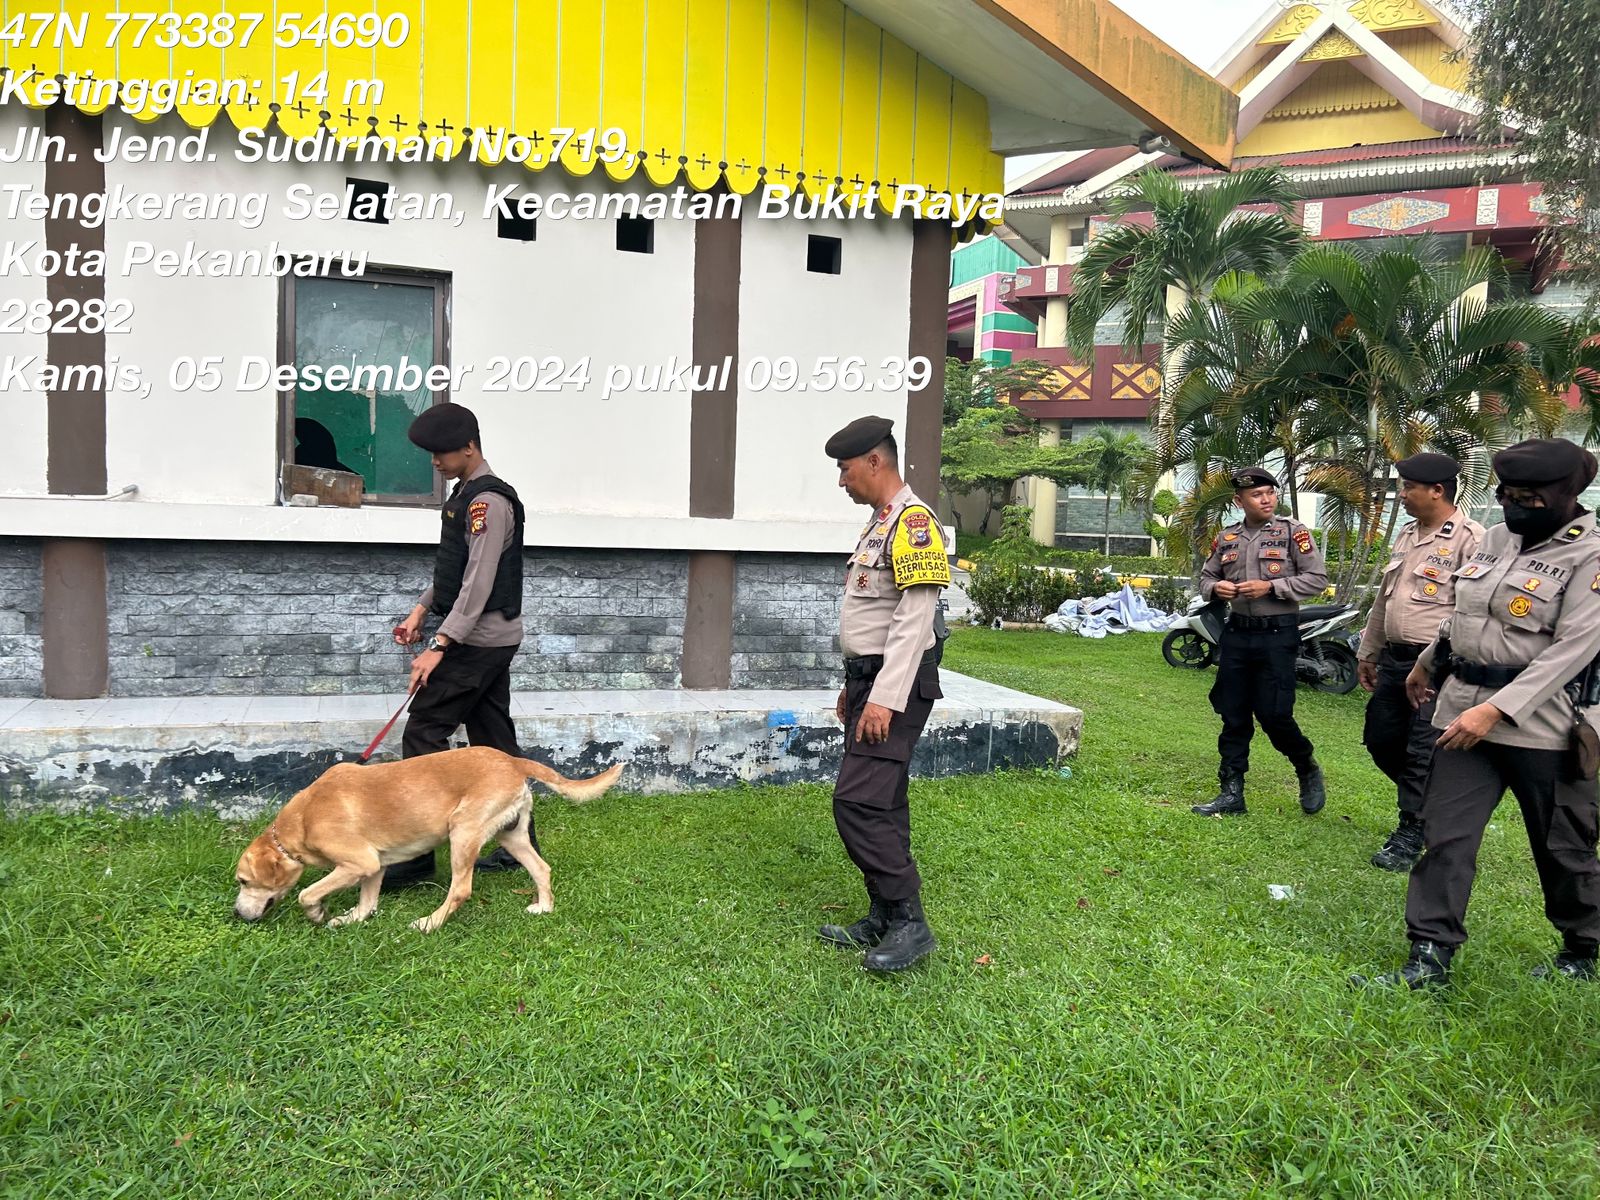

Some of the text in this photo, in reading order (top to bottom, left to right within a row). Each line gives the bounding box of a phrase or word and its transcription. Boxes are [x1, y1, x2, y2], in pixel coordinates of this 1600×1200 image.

[1261, 540, 1287, 548] POLRI
[895, 551, 945, 567] KASUBSATGAS
[1426, 554, 1452, 567] POLRI
[1474, 552, 1498, 564] SILVIA
[897, 561, 947, 577] STERILISASI
[1527, 559, 1566, 579] POLRI
